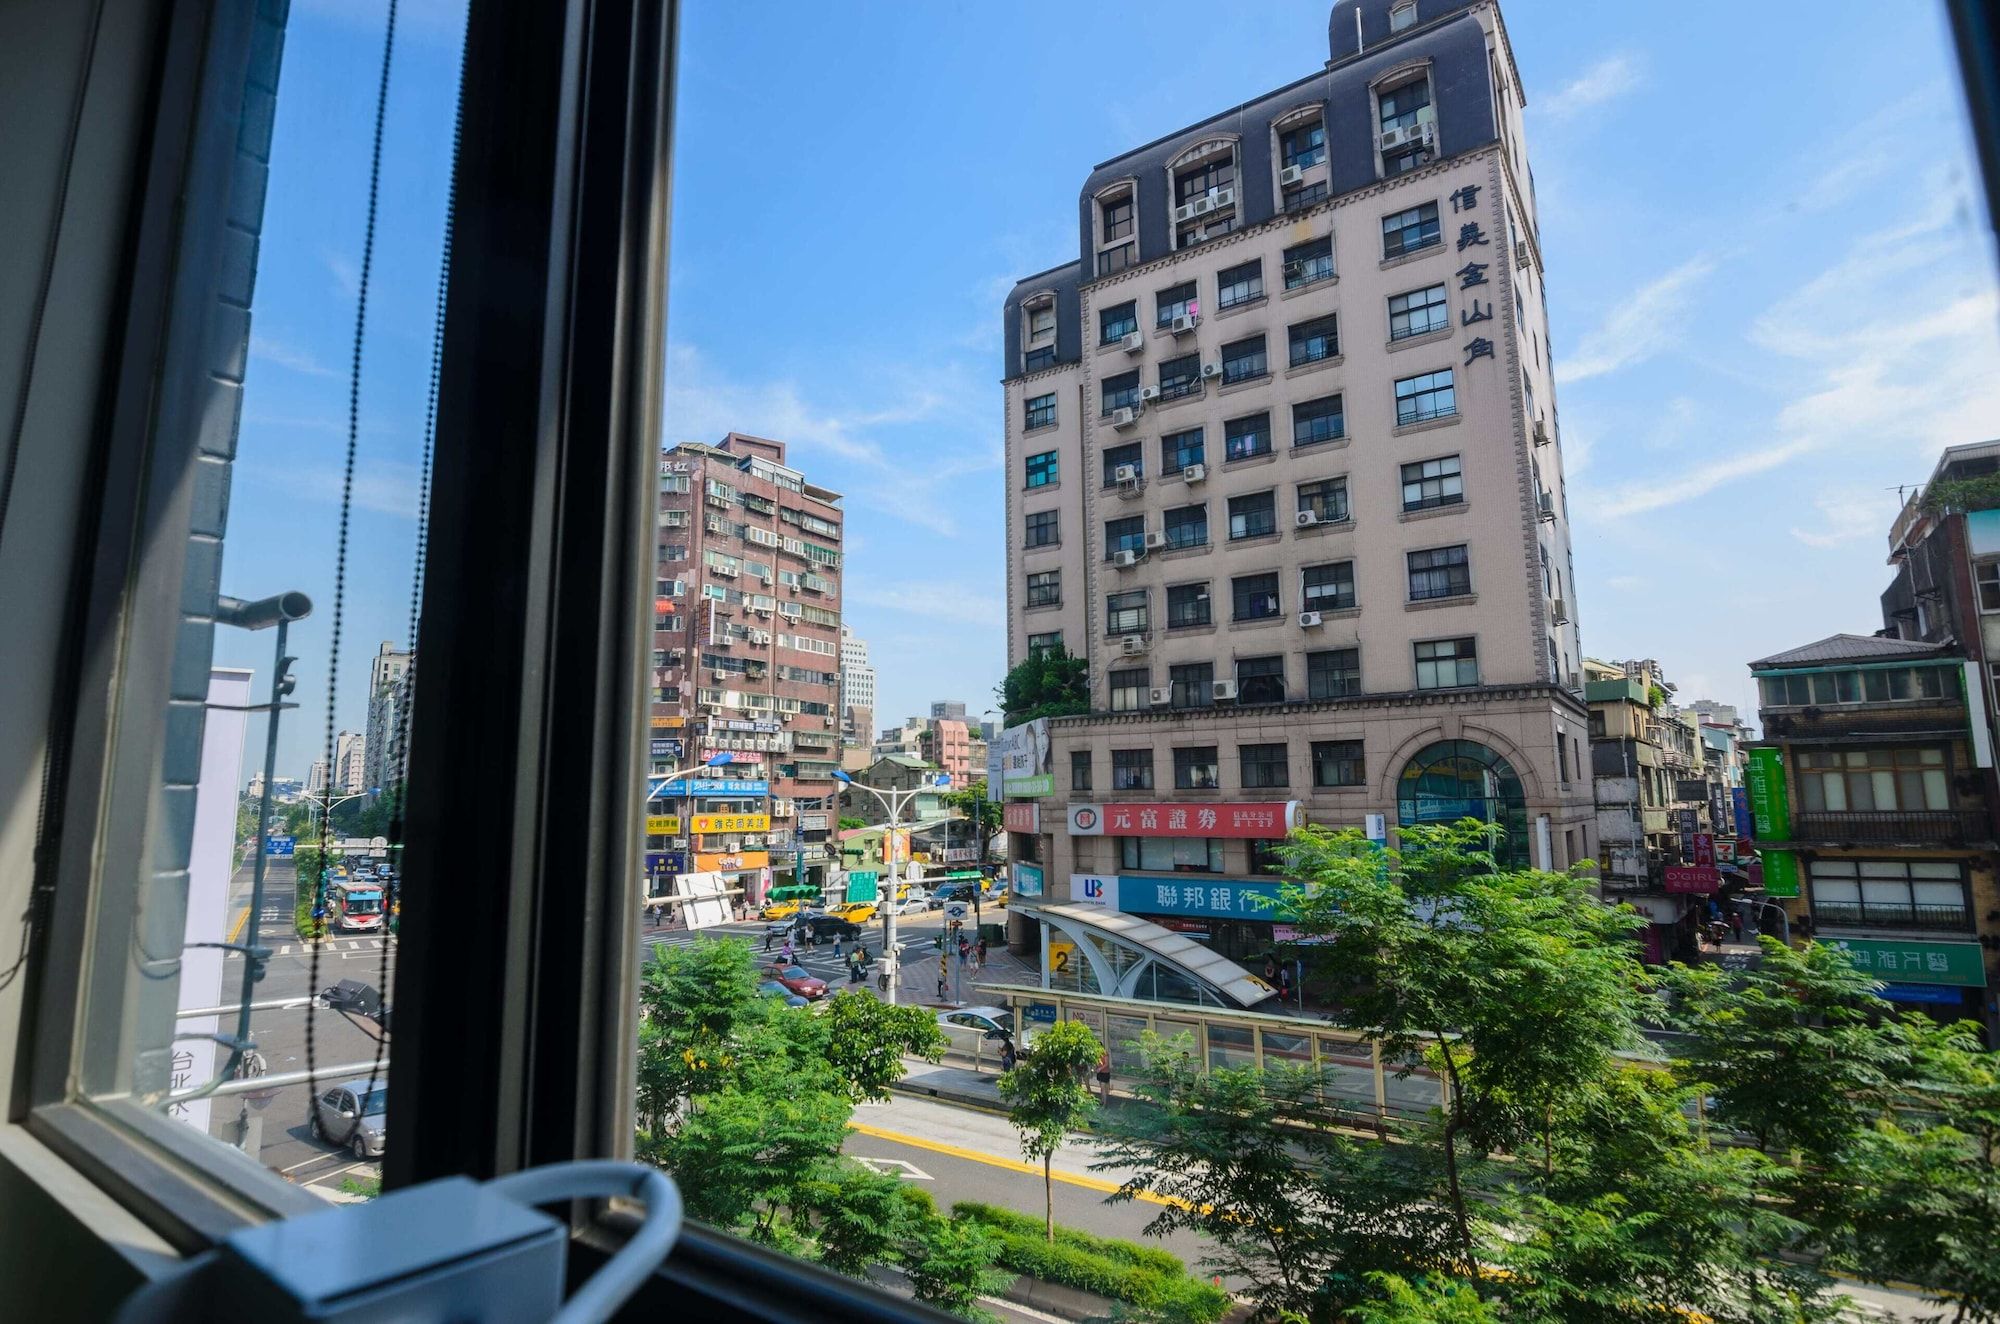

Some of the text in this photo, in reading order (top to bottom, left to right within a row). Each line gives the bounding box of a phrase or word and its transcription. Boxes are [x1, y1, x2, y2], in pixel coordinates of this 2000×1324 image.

[1449, 184, 1495, 366] 信義金山角
[1113, 808, 1217, 830] 元富證券
[1698, 835, 1711, 867] 東門
[1156, 884, 1262, 913] 聯邦銀行
[1056, 951, 1069, 972] 2
